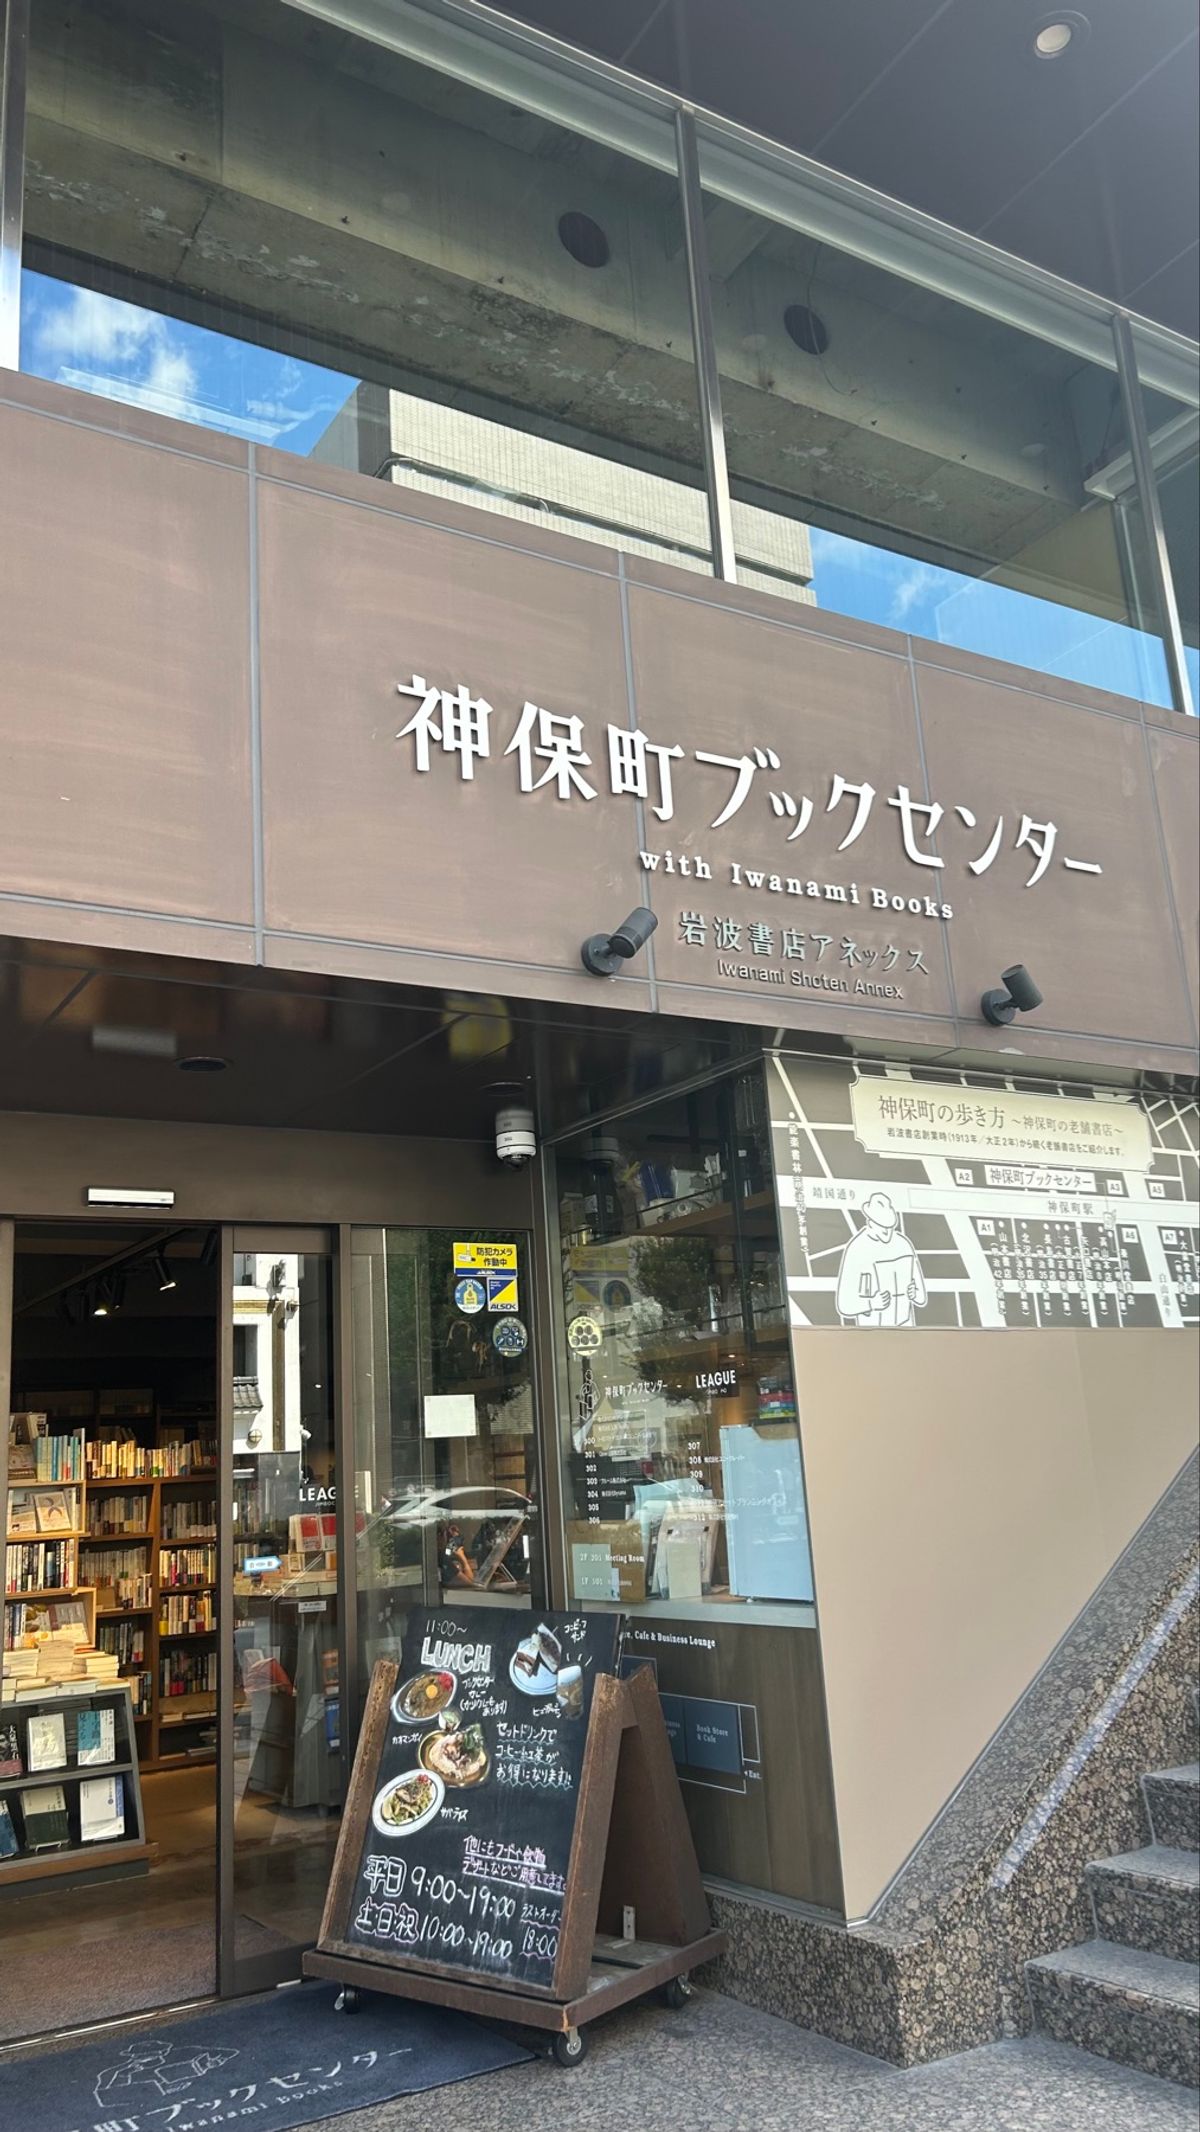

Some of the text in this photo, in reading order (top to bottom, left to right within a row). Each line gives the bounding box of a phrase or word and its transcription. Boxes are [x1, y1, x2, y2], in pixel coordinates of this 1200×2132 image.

[395, 675, 1103, 888] 神保町ブックセンター
[639, 849, 954, 920] with Iwanami Books
[678, 910, 930, 975] 岩波書店アネックス
[717, 960, 904, 1000] Iwanami Shoten Annex
[878, 1095, 1005, 1129] 神保町の歩き方
[959, 1173, 970, 1181] A2
[989, 1168, 1092, 1187] 神保町ブックセンター
[476, 1247, 513, 1256] 防犯カメラ
[484, 1258, 507, 1267] 作動中
[695, 1370, 736, 1389] LEAGUE
[299, 1486, 336, 1501] LEAG
[634, 1630, 650, 1640] Cafe
[650, 1632, 656, 1640] &
[657, 1633, 688, 1645] Business
[689, 1635, 716, 1649] Lounge
[421, 1637, 491, 1673] LUNCH
[496, 1722, 558, 1742] セットドリンクで
[365, 1855, 407, 1897] 平日
[523, 1927, 558, 1957] 18:00
